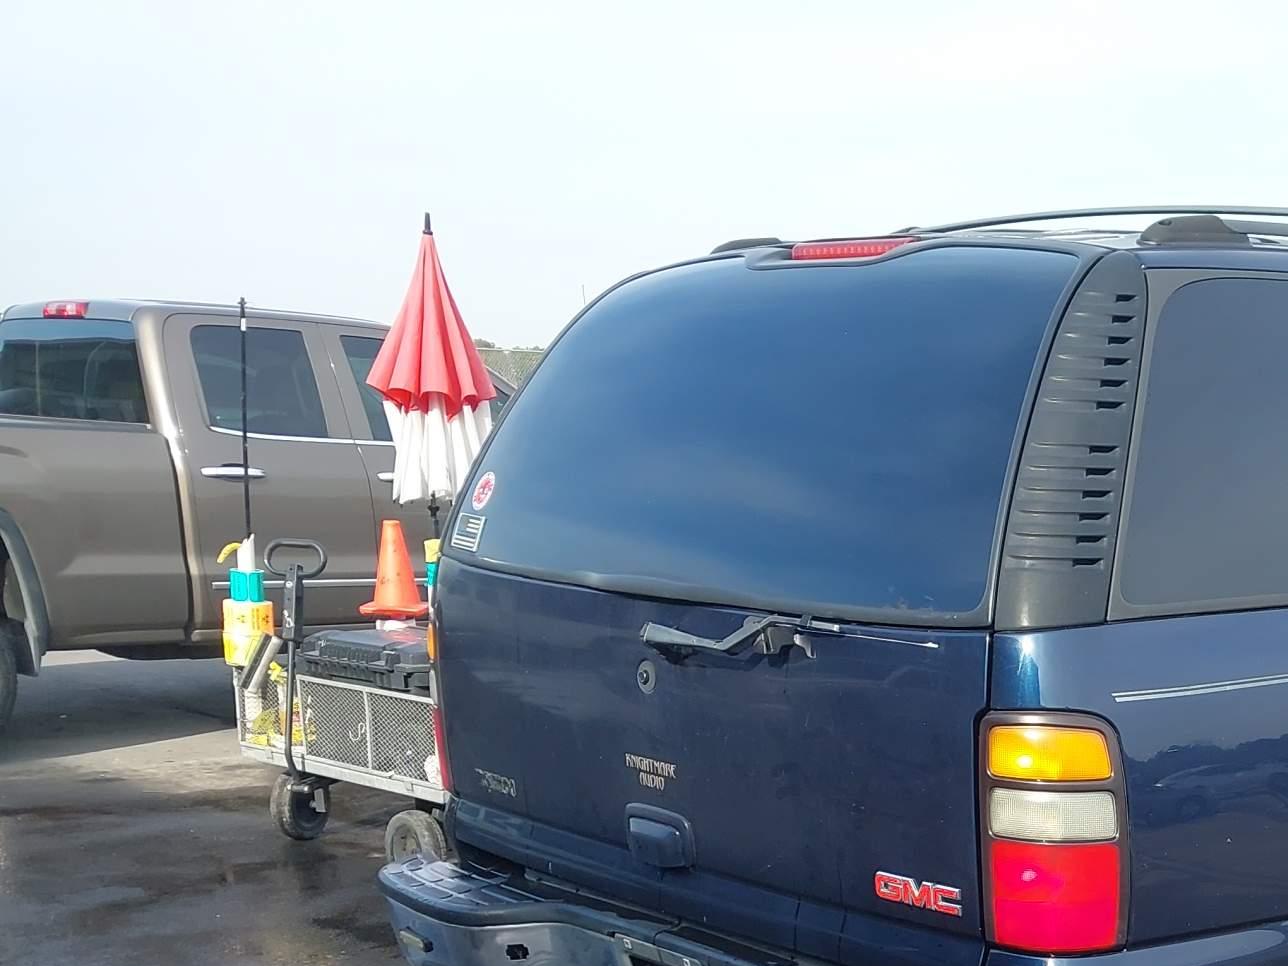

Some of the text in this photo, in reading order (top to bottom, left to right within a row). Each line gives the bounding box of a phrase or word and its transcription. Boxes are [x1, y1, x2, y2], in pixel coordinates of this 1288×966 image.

[625, 752, 677, 779] KNIGHTMARE
[639, 771, 665, 791] AUDIO
[874, 870, 962, 917] GMC
